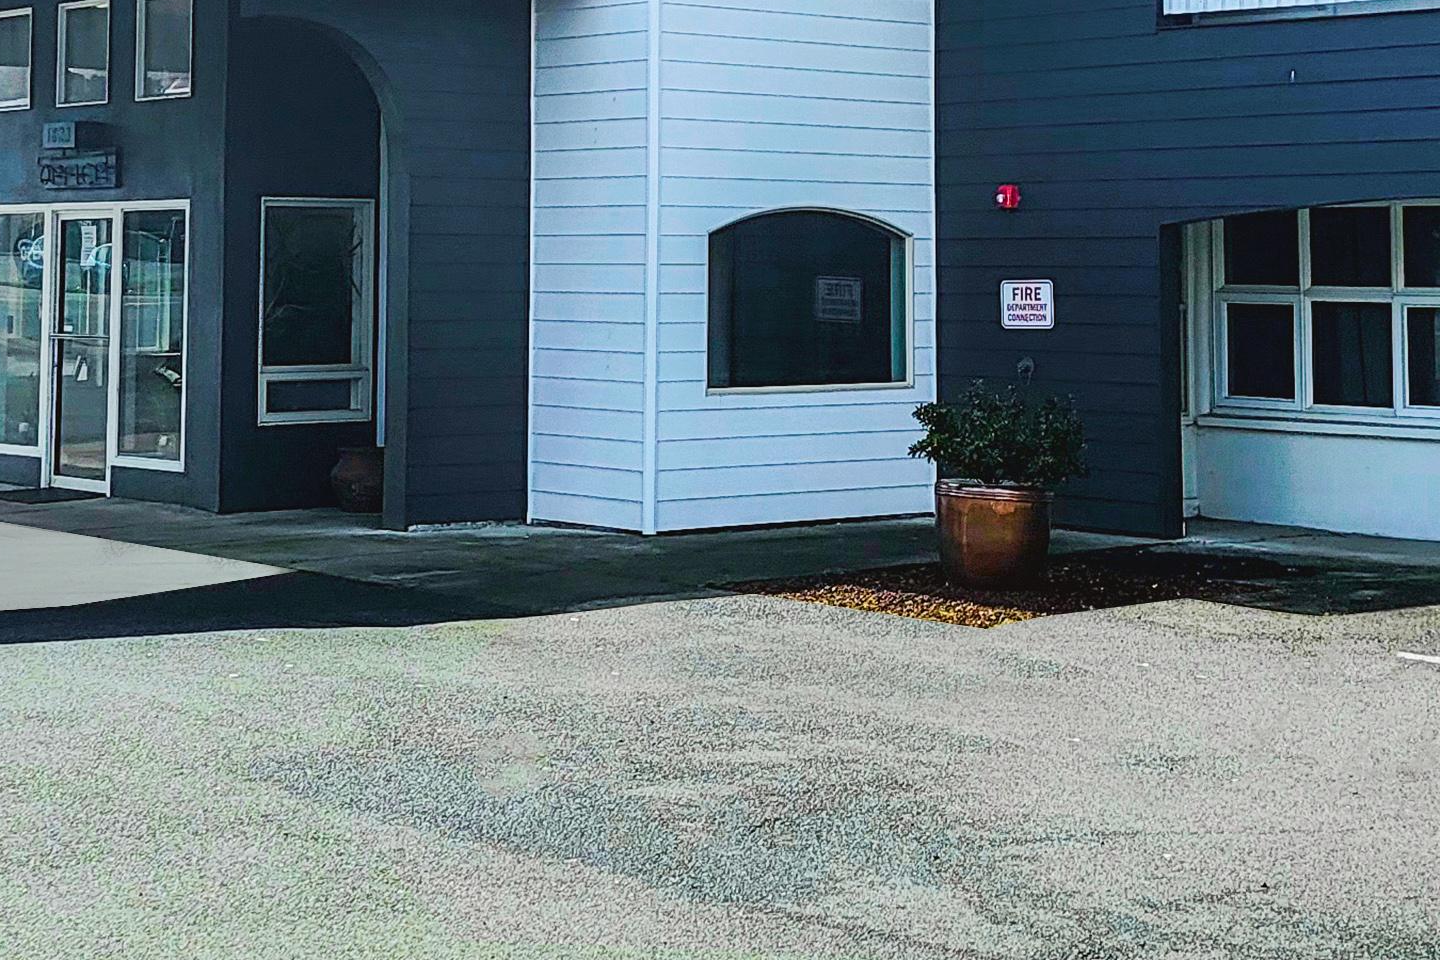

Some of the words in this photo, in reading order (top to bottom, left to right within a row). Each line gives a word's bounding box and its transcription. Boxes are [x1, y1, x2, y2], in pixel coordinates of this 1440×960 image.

[1012, 286, 1042, 301] FIRE
[1007, 303, 1047, 311] DEPARTMENT
[1008, 313, 1047, 322] CONNECTION
